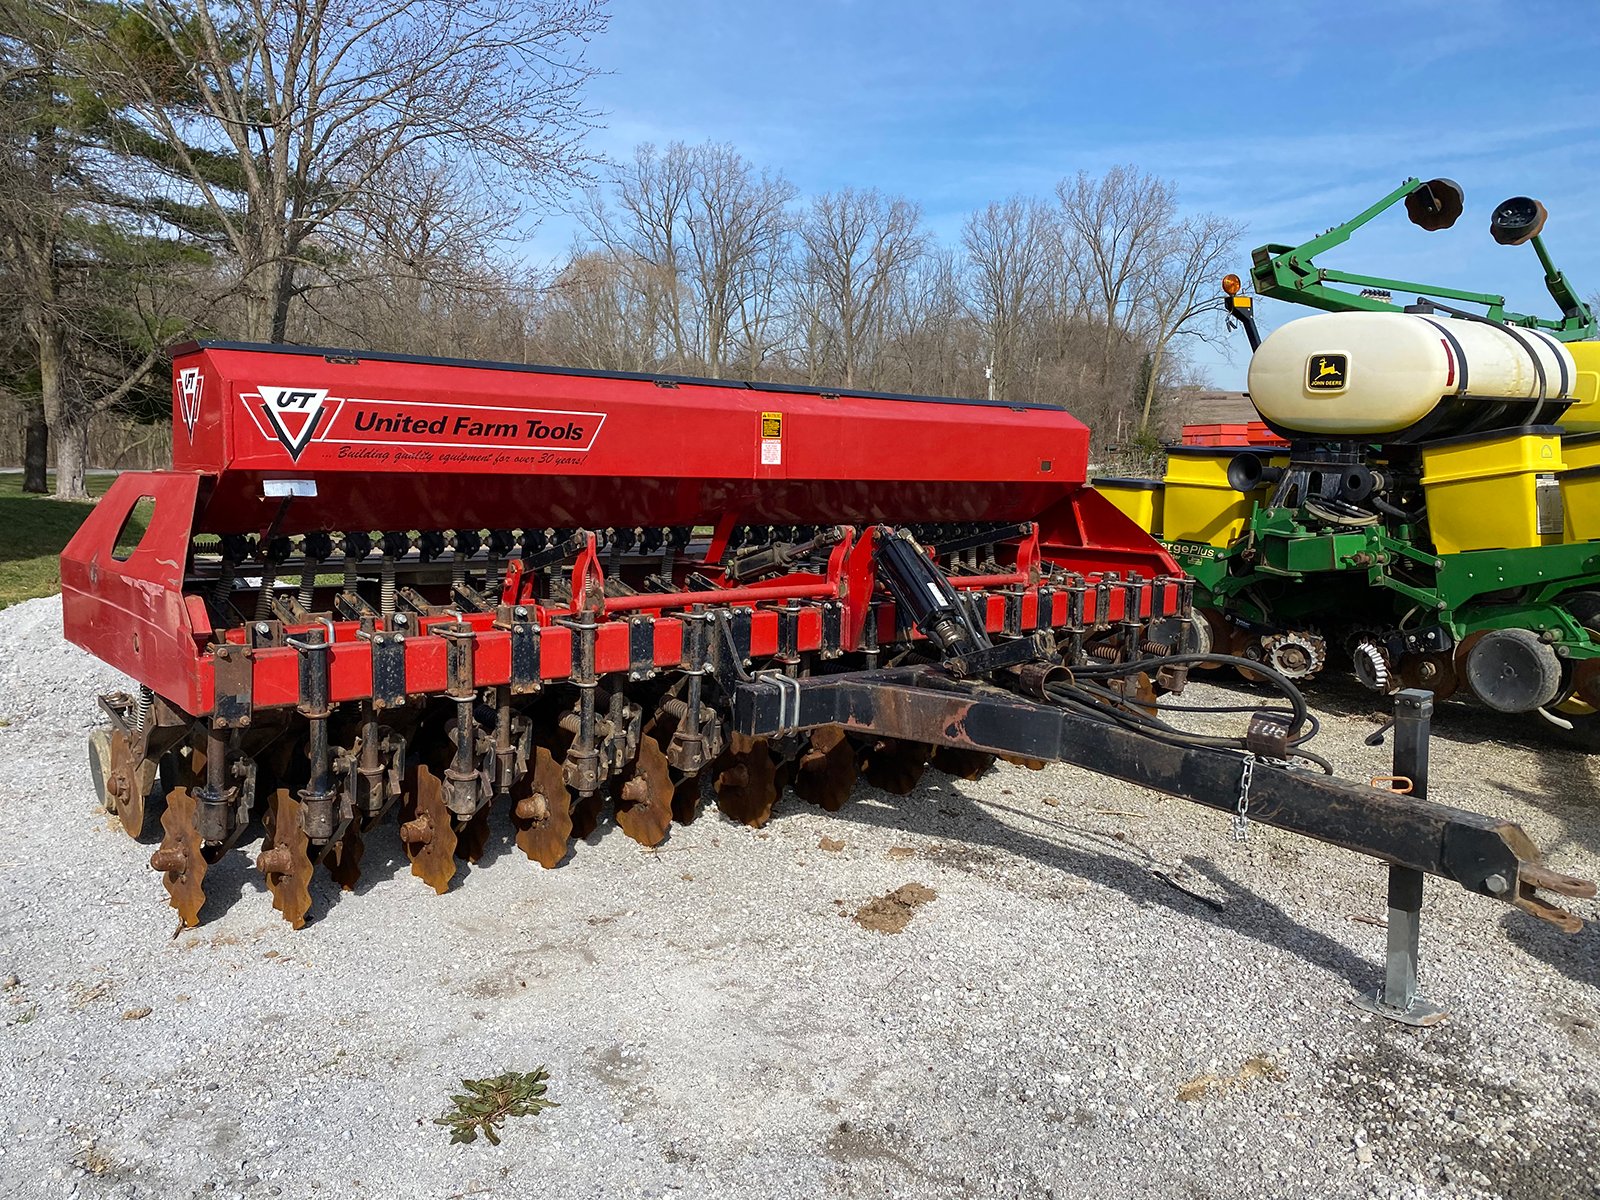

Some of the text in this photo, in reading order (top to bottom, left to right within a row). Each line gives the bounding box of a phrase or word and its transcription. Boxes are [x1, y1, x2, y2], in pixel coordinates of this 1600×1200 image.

[276, 391, 317, 409] UFT
[354, 411, 584, 441] United Farm Tools
[338, 446, 390, 463] Building
[394, 449, 434, 464] quality
[438, 451, 493, 465] equipment
[493, 452, 511, 466] for
[514, 455, 535, 464] over
[537, 452, 555, 465] 30
[555, 454, 588, 466] years!
[1160, 542, 1215, 557] ergePlus
